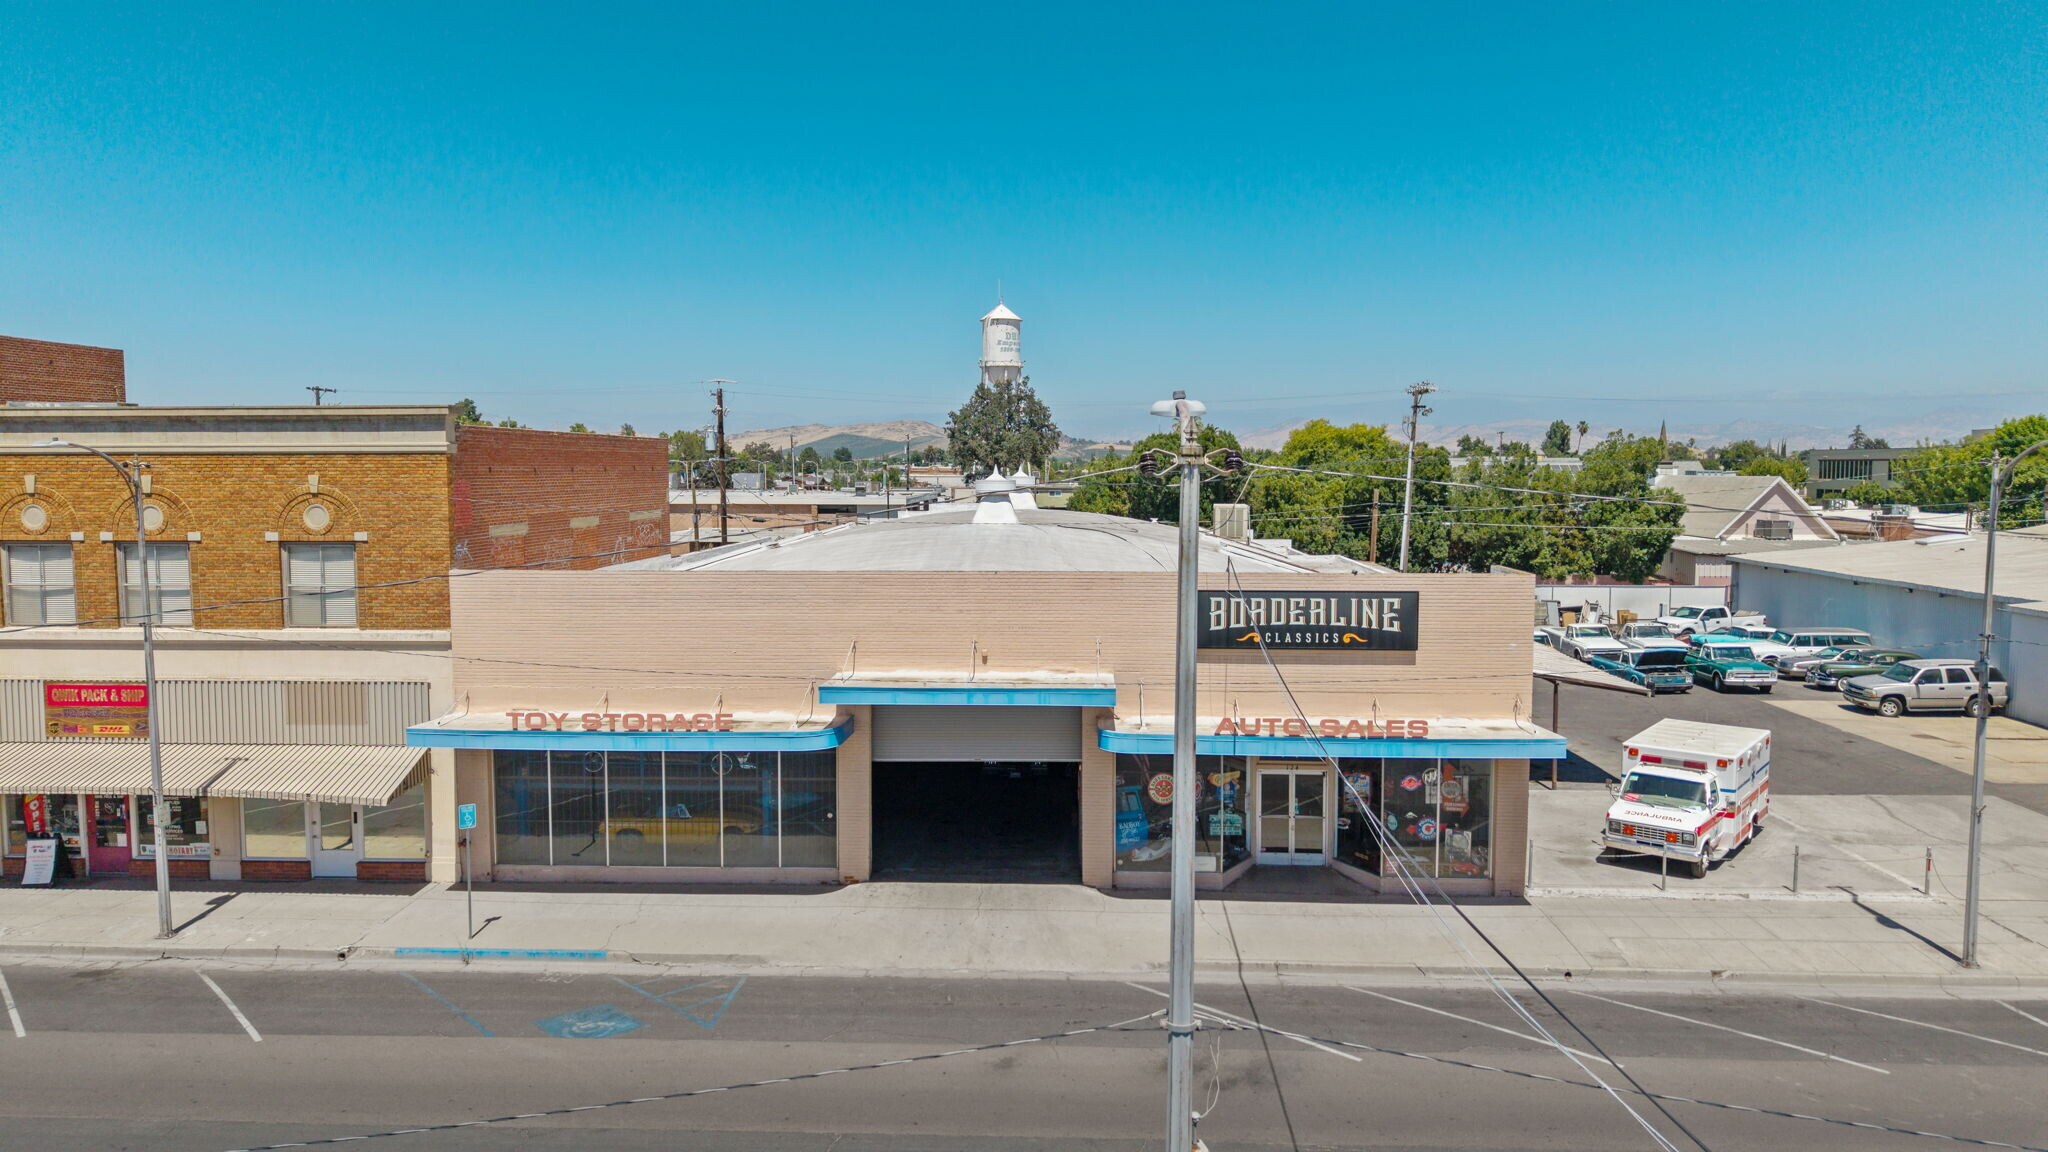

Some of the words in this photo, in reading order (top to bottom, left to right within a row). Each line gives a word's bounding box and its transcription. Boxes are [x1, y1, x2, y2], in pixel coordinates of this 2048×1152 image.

[1209, 597, 1402, 632] BORDERLINE
[1265, 632, 1340, 644] CLASSICS
[51, 688, 79, 702] QWIK
[80, 688, 108, 702] PACK
[110, 689, 119, 702] &
[120, 689, 145, 702] SHIP
[505, 712, 569, 731] TOY
[581, 713, 733, 732] STORAGE
[1214, 717, 1308, 736] AUTO
[1319, 719, 1429, 738] SALES
